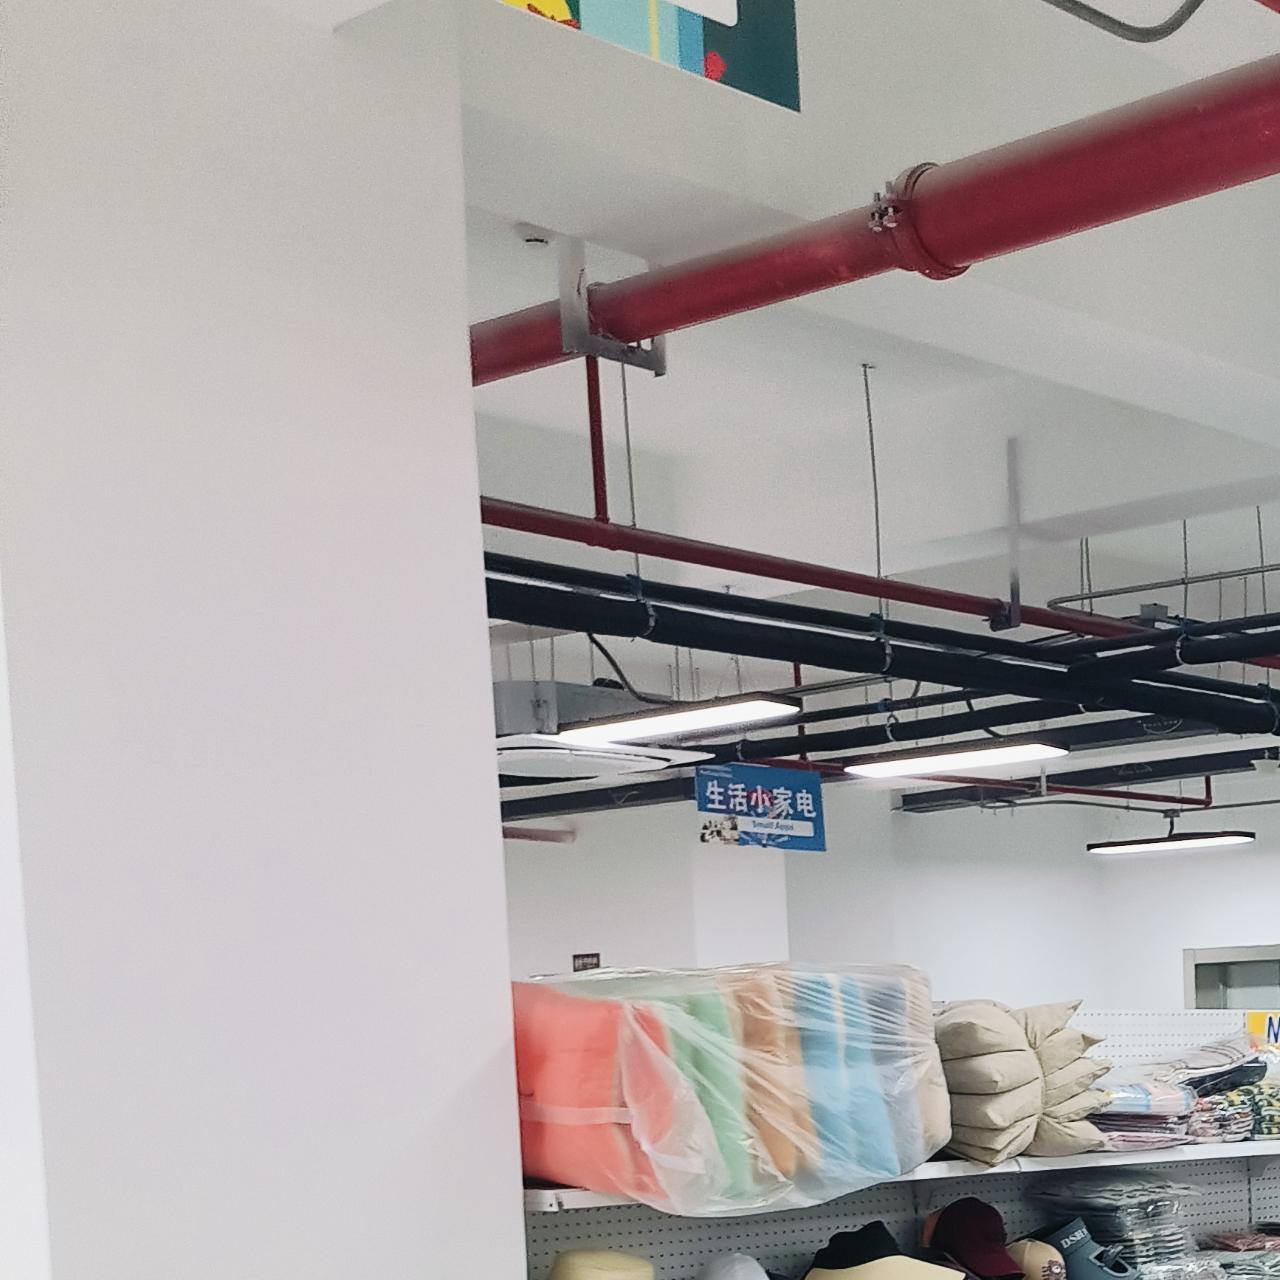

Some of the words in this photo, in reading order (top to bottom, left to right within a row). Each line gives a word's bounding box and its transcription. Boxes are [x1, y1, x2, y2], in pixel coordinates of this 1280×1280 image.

[705, 779, 817, 818] 生活小家电
